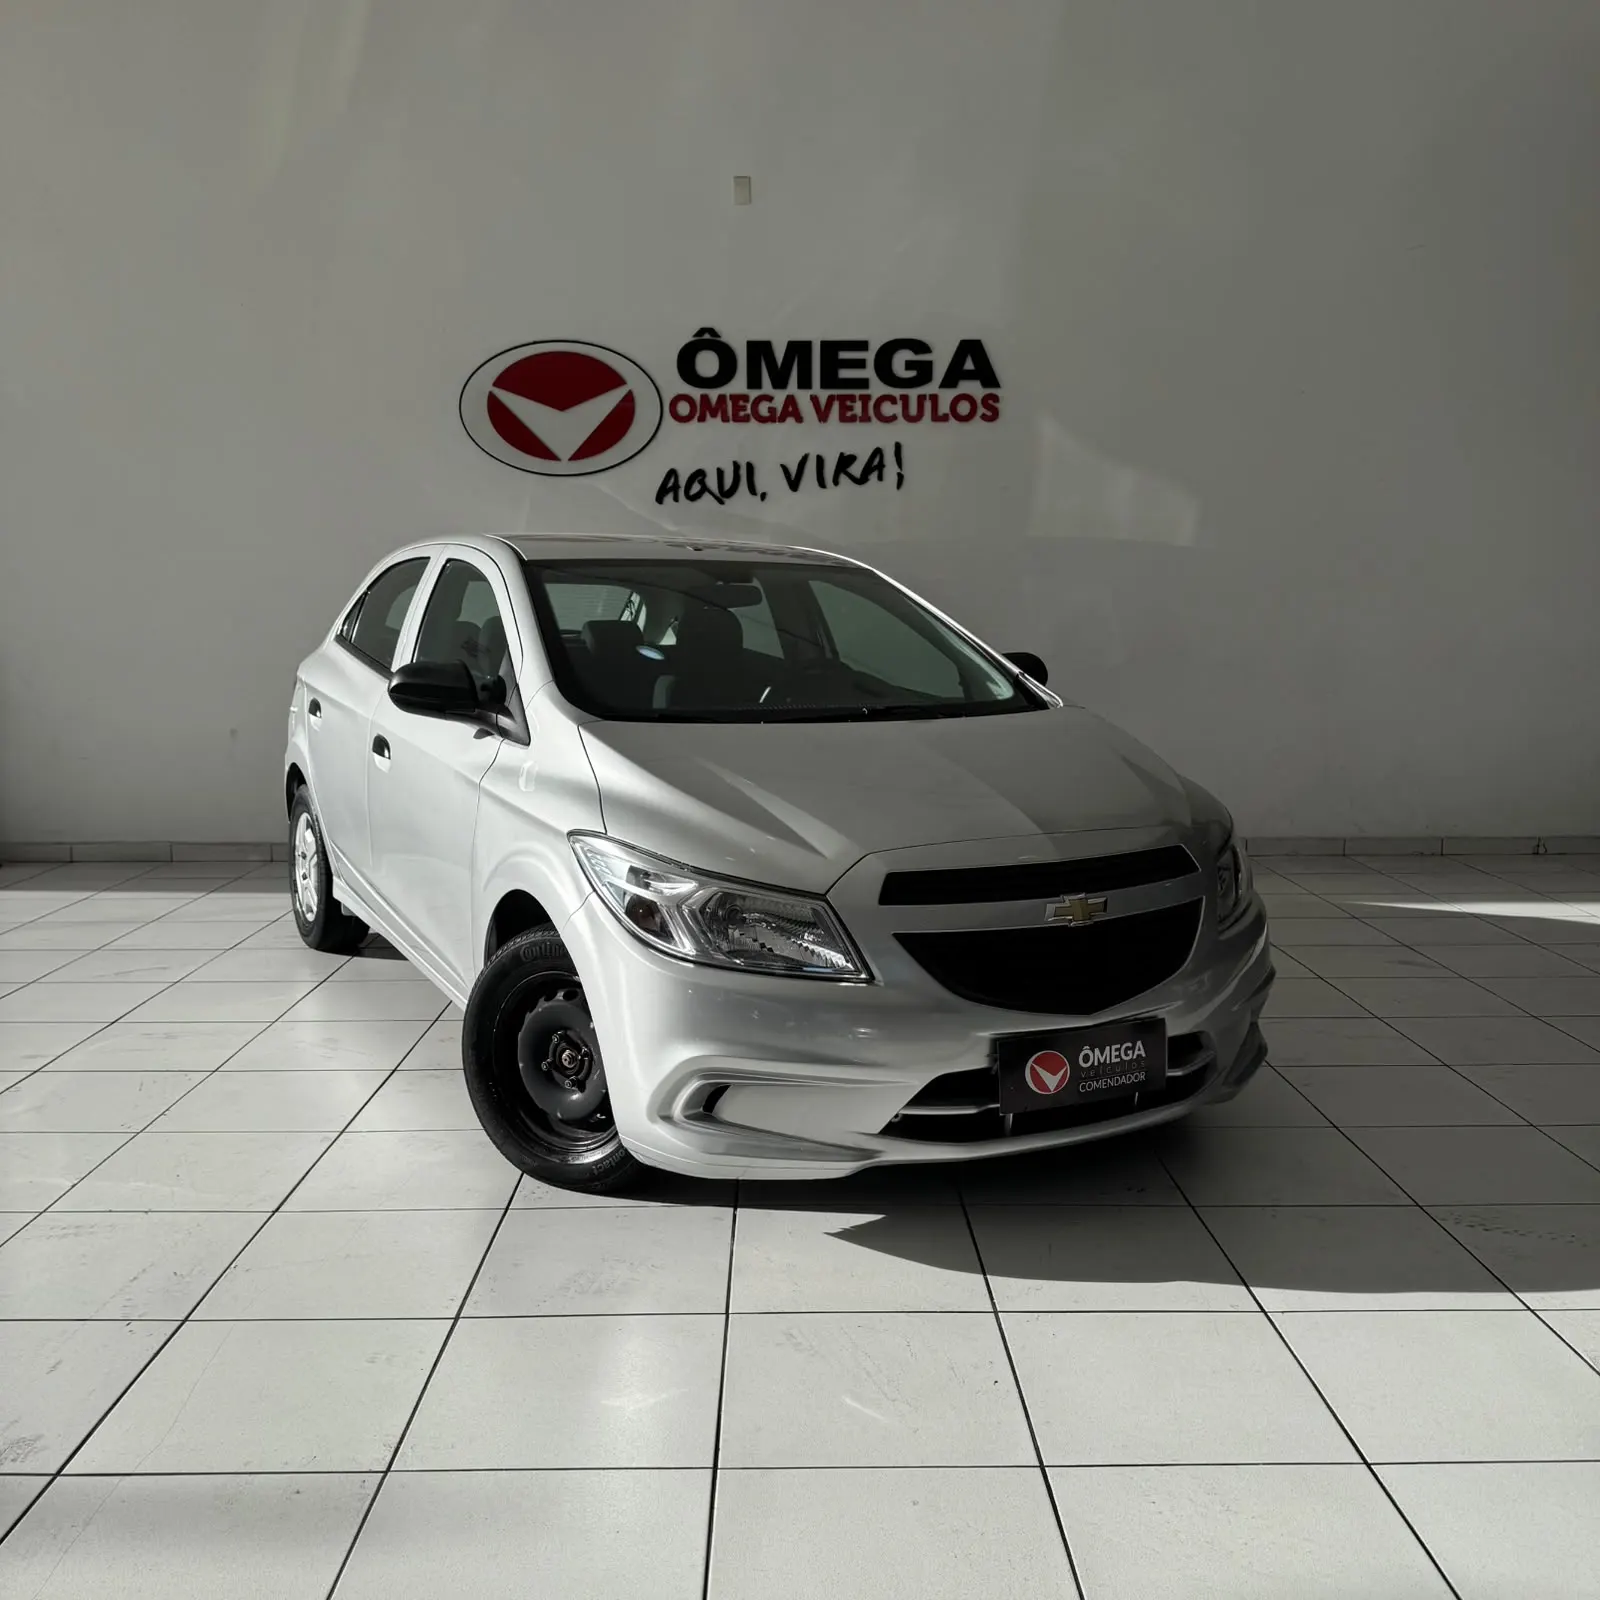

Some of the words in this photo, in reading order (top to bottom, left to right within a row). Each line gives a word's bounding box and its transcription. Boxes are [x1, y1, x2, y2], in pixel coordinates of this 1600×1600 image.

[677, 327, 1002, 390] ÔMEGA
[669, 393, 803, 424] OMEGA
[810, 393, 1000, 424] VEICULOS
[655, 461, 767, 505] AQUI,
[780, 442, 905, 492] VIRA!
[1078, 1040, 1147, 1068] ÔMEGA
[1079, 1071, 1147, 1093] COMENDADOR
[591, 1148, 626, 1177] ontact
